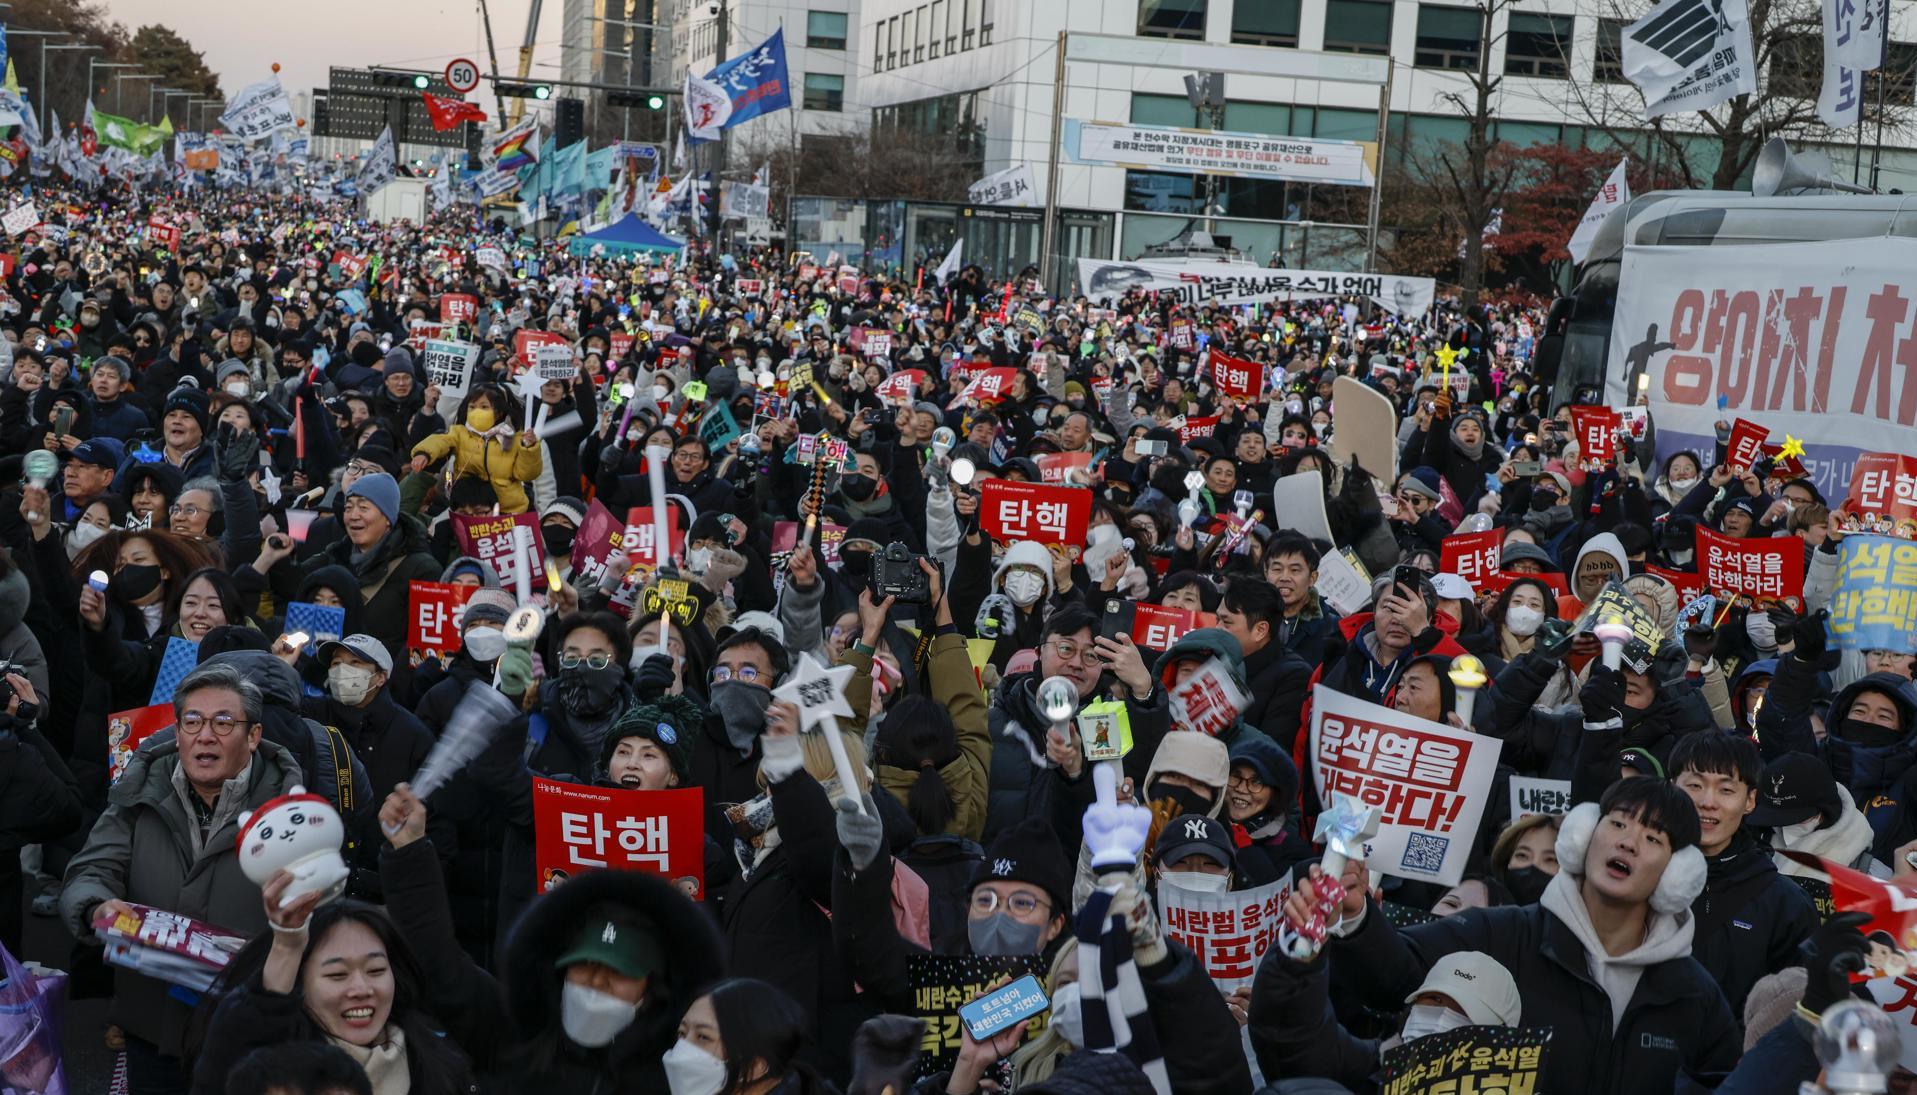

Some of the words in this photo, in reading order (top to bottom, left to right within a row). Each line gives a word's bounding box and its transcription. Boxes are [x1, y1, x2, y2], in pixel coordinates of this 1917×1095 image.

[453, 68, 472, 84] 50
[526, 340, 568, 363] 탄
[1664, 288, 1847, 413] 양아치
[1214, 362, 1249, 393] 탄핵
[798, 435, 848, 473] 탄핵
[999, 500, 1068, 541] 탄핵
[1457, 544, 1501, 588] 탄핵
[1708, 546, 1784, 574] 윤석열을
[1708, 567, 1784, 597] 탄핵하라
[1320, 718, 1460, 787] 윤석열을
[538, 784, 561, 795] 나눔문화
[563, 790, 611, 801] www.nanum.com
[562, 812, 670, 873] 탄핵
[1184, 819, 1208, 840] NY
[1167, 906, 1235, 934] 내란범
[981, 989, 1021, 1014] 토트넘아
[973, 1010, 1012, 1033] 대한민국
[1470, 1046, 1541, 1071] 윤석열
